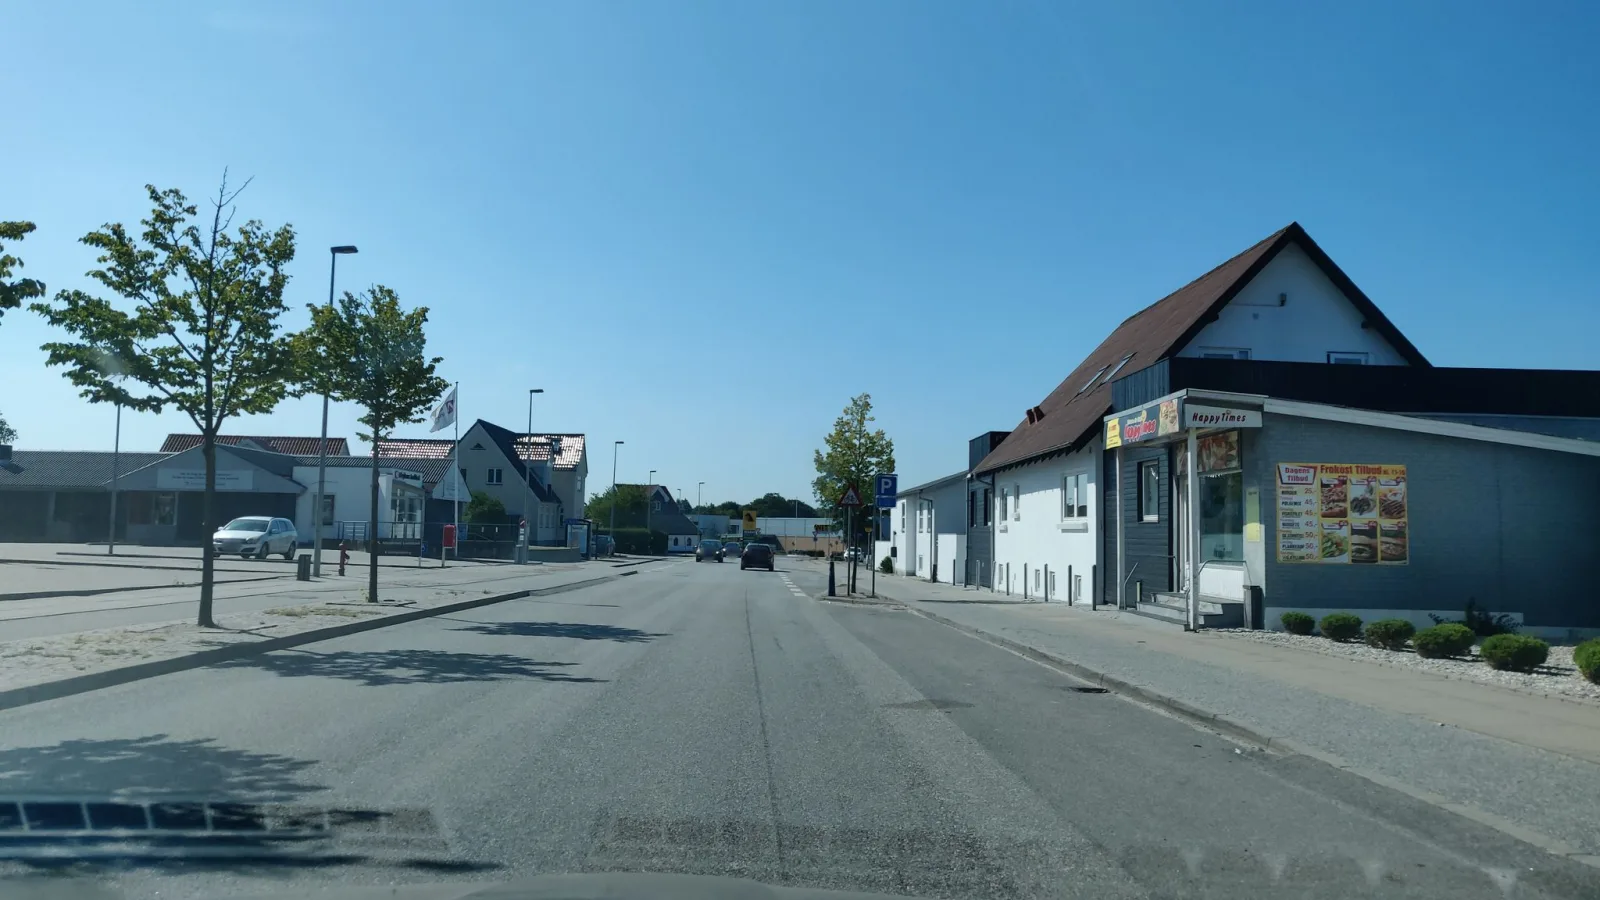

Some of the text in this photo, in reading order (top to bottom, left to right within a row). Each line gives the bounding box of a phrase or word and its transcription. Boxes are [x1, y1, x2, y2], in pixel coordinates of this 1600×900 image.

[1320, 464, 1353, 474] Frokost
[1355, 465, 1382, 475] Tilbud
[881, 478, 892, 494] P
